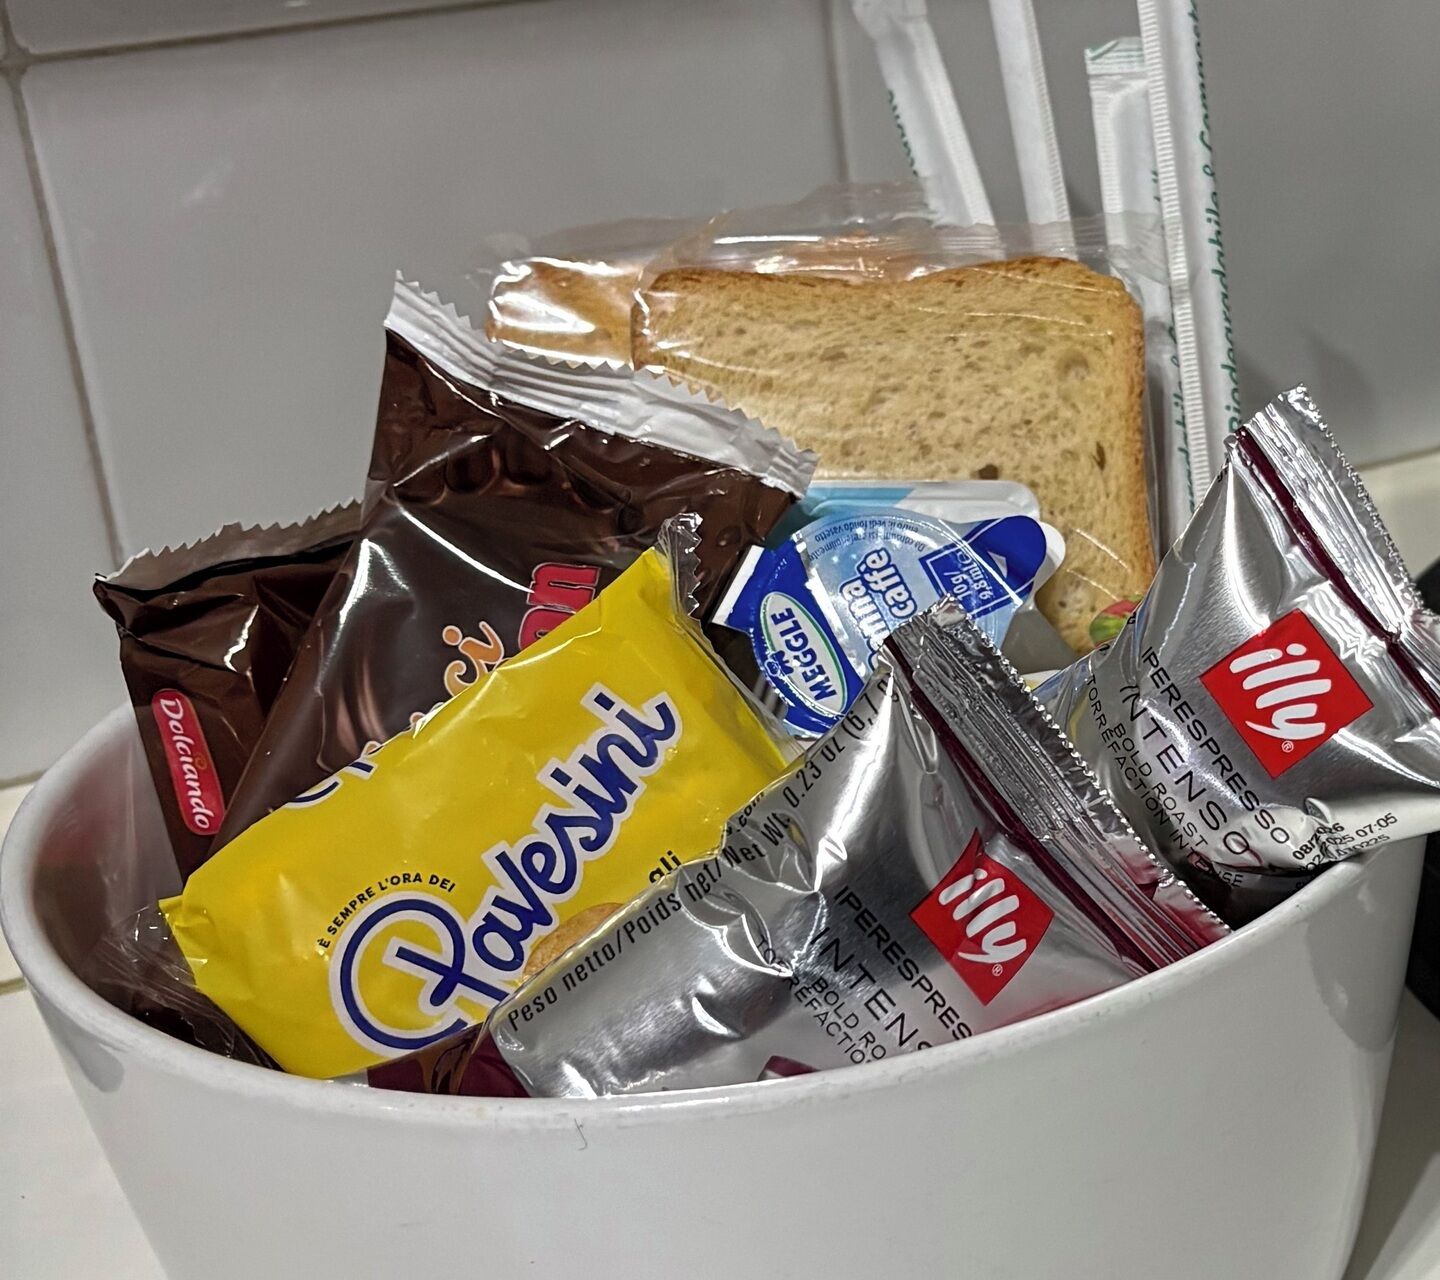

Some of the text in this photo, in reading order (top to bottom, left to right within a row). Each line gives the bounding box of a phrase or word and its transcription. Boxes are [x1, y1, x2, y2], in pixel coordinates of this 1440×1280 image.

[855, 547, 918, 620] caffè
[770, 606, 838, 702] MEGGLE
[1229, 642, 1333, 741] illy
[158, 696, 211, 831] Dolciando
[1113, 722, 1209, 848] BOLD ROAST
[1120, 684, 1251, 857] INTENSO
[1141, 645, 1291, 846] IPERESPRESSO
[340, 691, 676, 1051] Pavesini
[1354, 812, 1398, 838] 07:05
[327, 884, 375, 936] SEMPRE
[378, 872, 423, 894] L'ORA
[429, 874, 456, 894] DEI
[507, 984, 559, 1032] Peso
[782, 761, 822, 809] 0.23
[938, 867, 1028, 965] illy
[756, 934, 873, 1064] TORÉFACTIO
[811, 976, 860, 1030] BOLD
